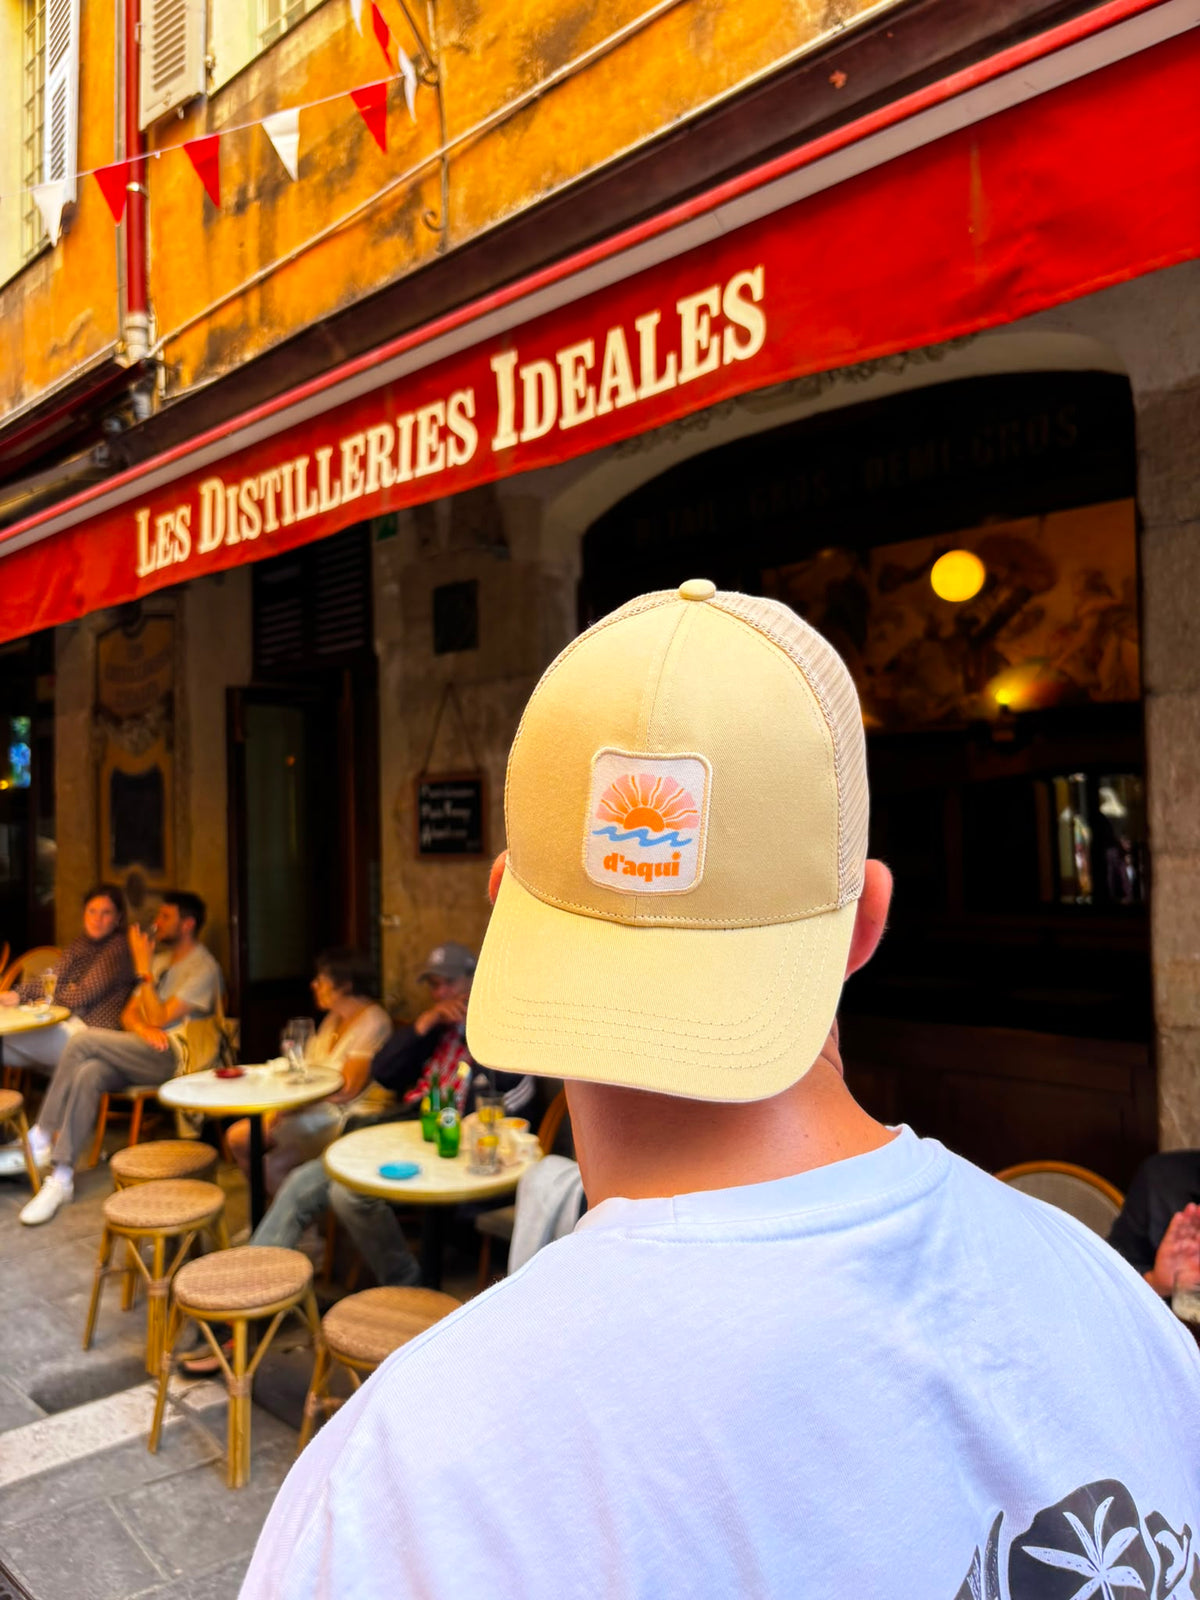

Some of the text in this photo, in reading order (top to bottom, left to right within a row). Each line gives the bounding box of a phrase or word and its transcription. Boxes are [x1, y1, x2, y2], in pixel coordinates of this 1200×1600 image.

[135, 264, 766, 578] LES DISTILLERIES IDEALES
[603, 851, 681, 882] d'aqui
